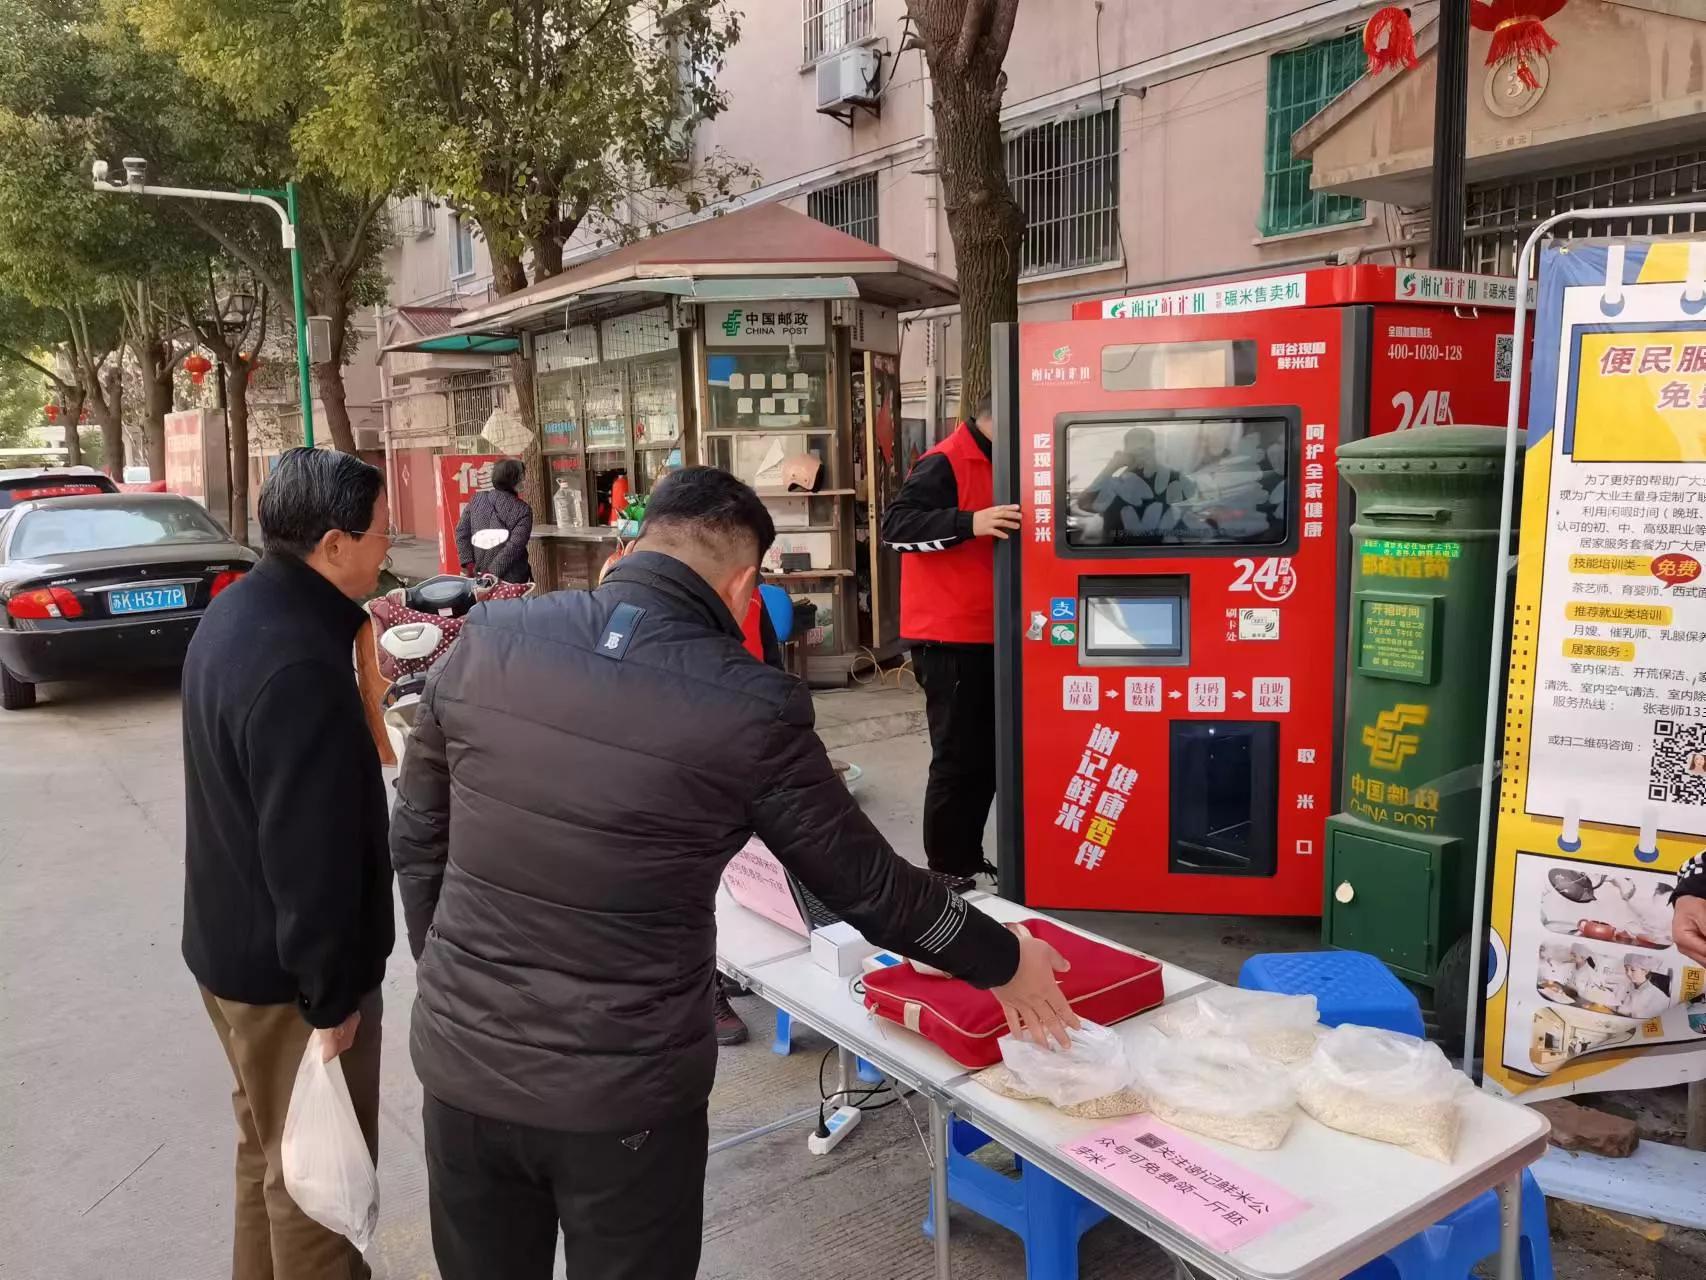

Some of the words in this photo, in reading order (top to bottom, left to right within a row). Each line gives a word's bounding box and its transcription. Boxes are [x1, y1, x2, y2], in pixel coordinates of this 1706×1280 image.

[1224, 282, 1300, 306] 碾米售卖机
[1489, 282, 1534, 303] 碾米售机
[746, 312, 809, 326] 中国邮政
[745, 327, 775, 336] CHINA
[782, 327, 809, 336] POST
[1388, 344, 1463, 361] 400-1030-128
[1600, 345, 1706, 375] 便民服
[1657, 380, 1706, 409] 免
[1392, 390, 1439, 431] 24
[1303, 423, 1325, 538] 呵护全家健康
[1228, 557, 1280, 592] 24
[1655, 559, 1698, 577] 免费
[1371, 603, 1420, 618] 开箱时间
[1574, 605, 1662, 621] 推荐就业类培训
[1225, 608, 1238, 642] 刷卡处
[1068, 680, 1093, 693] 点击
[1131, 681, 1156, 694] 选择
[1194, 682, 1219, 694] 扫码
[1259, 682, 1284, 695] 自助
[1068, 693, 1093, 706] 屏幕
[1131, 694, 1156, 707] 数量
[1194, 694, 1219, 708] 支付
[1259, 695, 1284, 708] 取米
[1054, 722, 1120, 833] 谢记鲜米
[1296, 748, 1316, 855] 取米口
[1073, 762, 1140, 871] 健康香伴
[1350, 797, 1389, 823] CHINA
[1393, 811, 1437, 832] POST
[1095, 1136, 1249, 1227] 众号可免费领一斤胚
[1154, 1146, 1270, 1215] 关注谢记鲜米公
